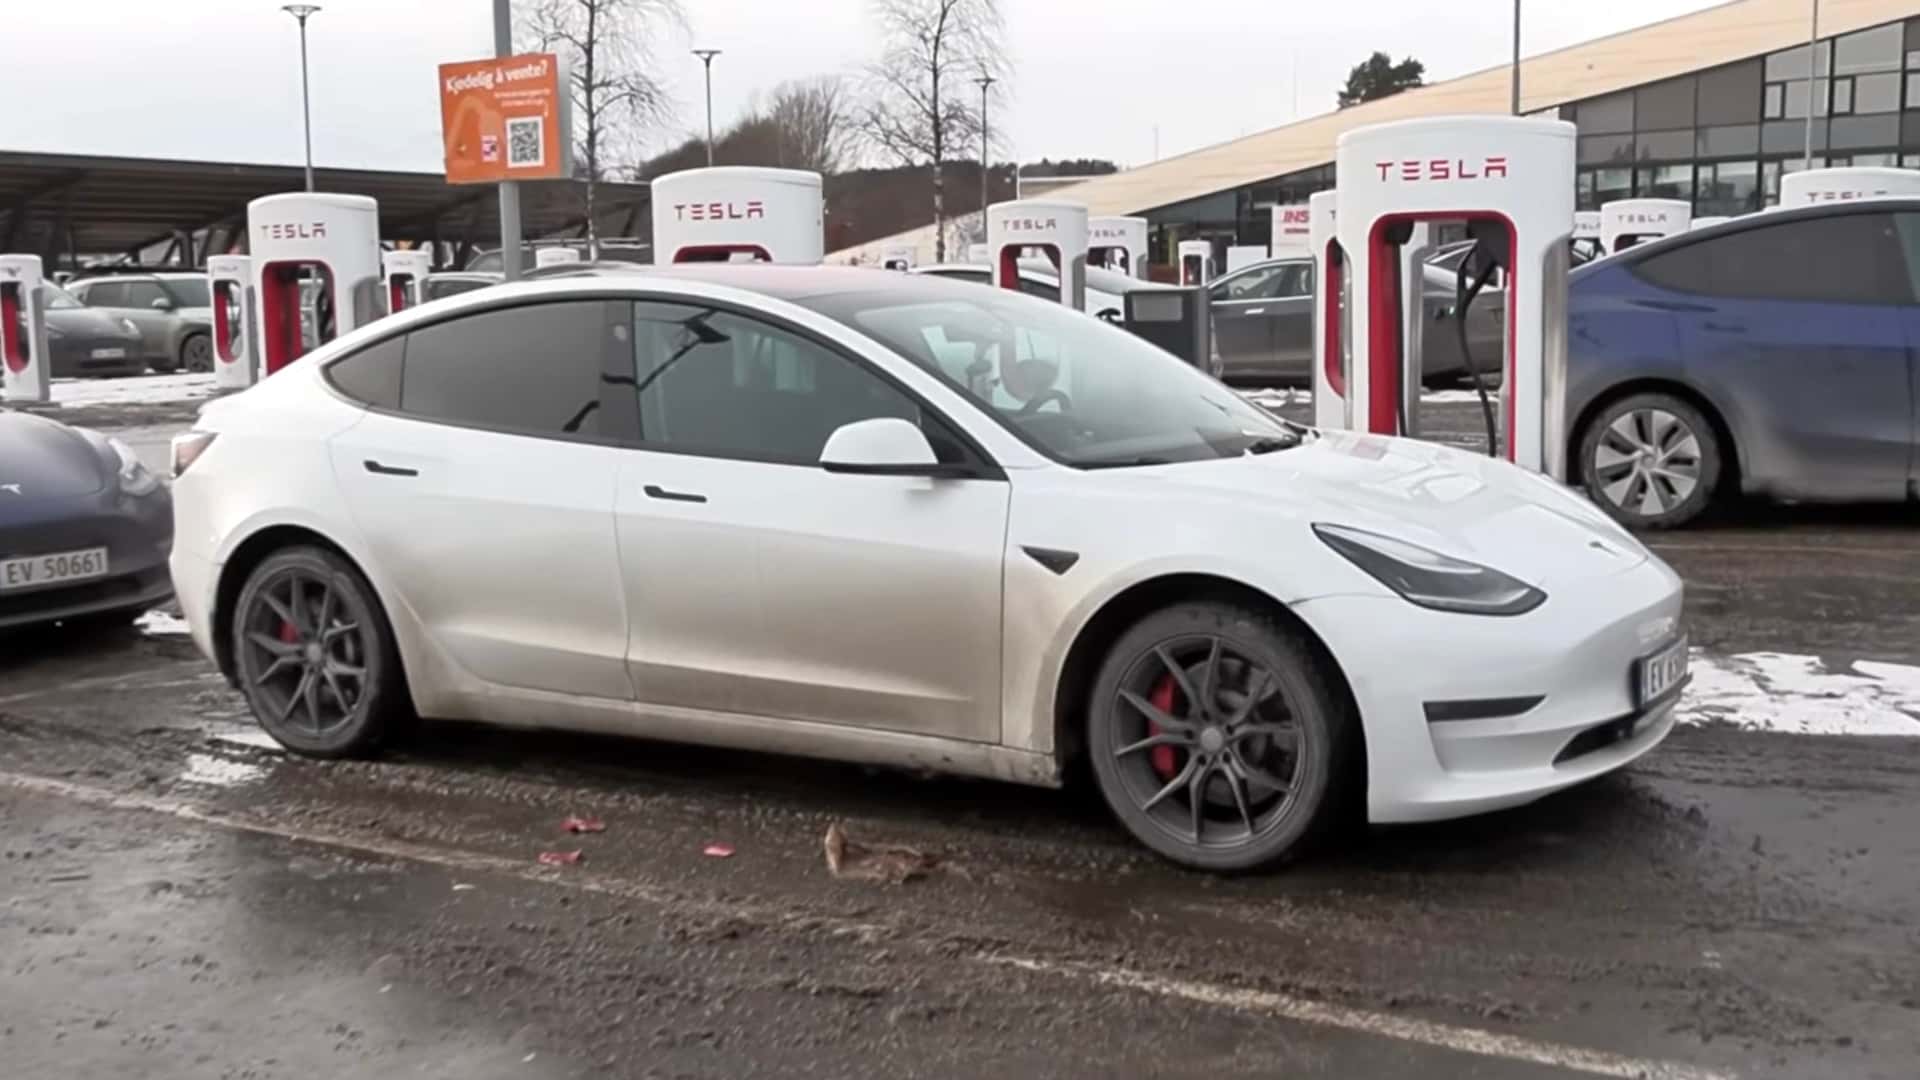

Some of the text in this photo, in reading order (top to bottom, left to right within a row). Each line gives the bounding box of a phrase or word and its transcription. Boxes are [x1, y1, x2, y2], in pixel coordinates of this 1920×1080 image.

[1376, 158, 1507, 182] TESLA
[1808, 190, 1887, 202] TES
[674, 202, 763, 220] TESLA
[1618, 213, 1667, 223] TESLA
[261, 223, 325, 239] TESLA
[1003, 219, 1056, 231] TESLA
[7, 552, 102, 585] EV 50661
